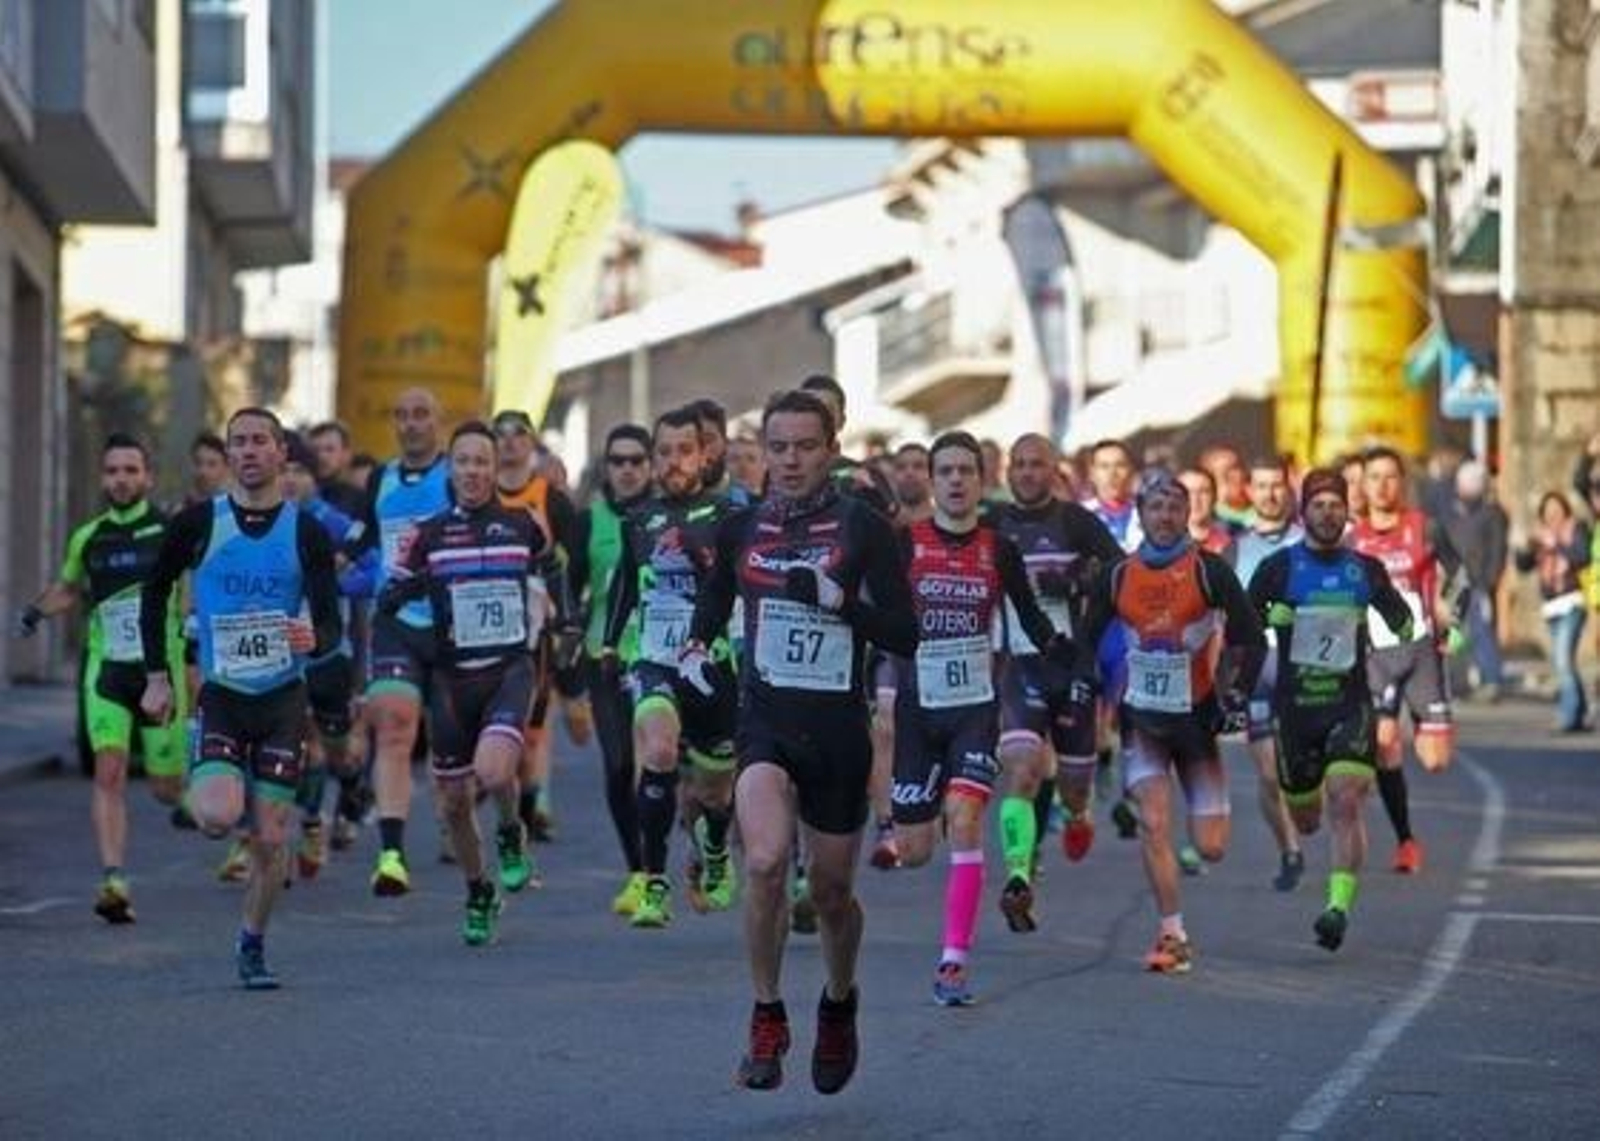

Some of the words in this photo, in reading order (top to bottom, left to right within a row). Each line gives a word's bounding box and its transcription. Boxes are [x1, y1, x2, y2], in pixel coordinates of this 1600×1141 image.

[478, 600, 504, 628] 79
[922, 608, 978, 633] OTERO
[238, 633, 268, 658] 48
[786, 628, 824, 664] 57
[1319, 634, 1333, 661] 2
[945, 660, 969, 687] 61
[1144, 672, 1170, 696] 87
